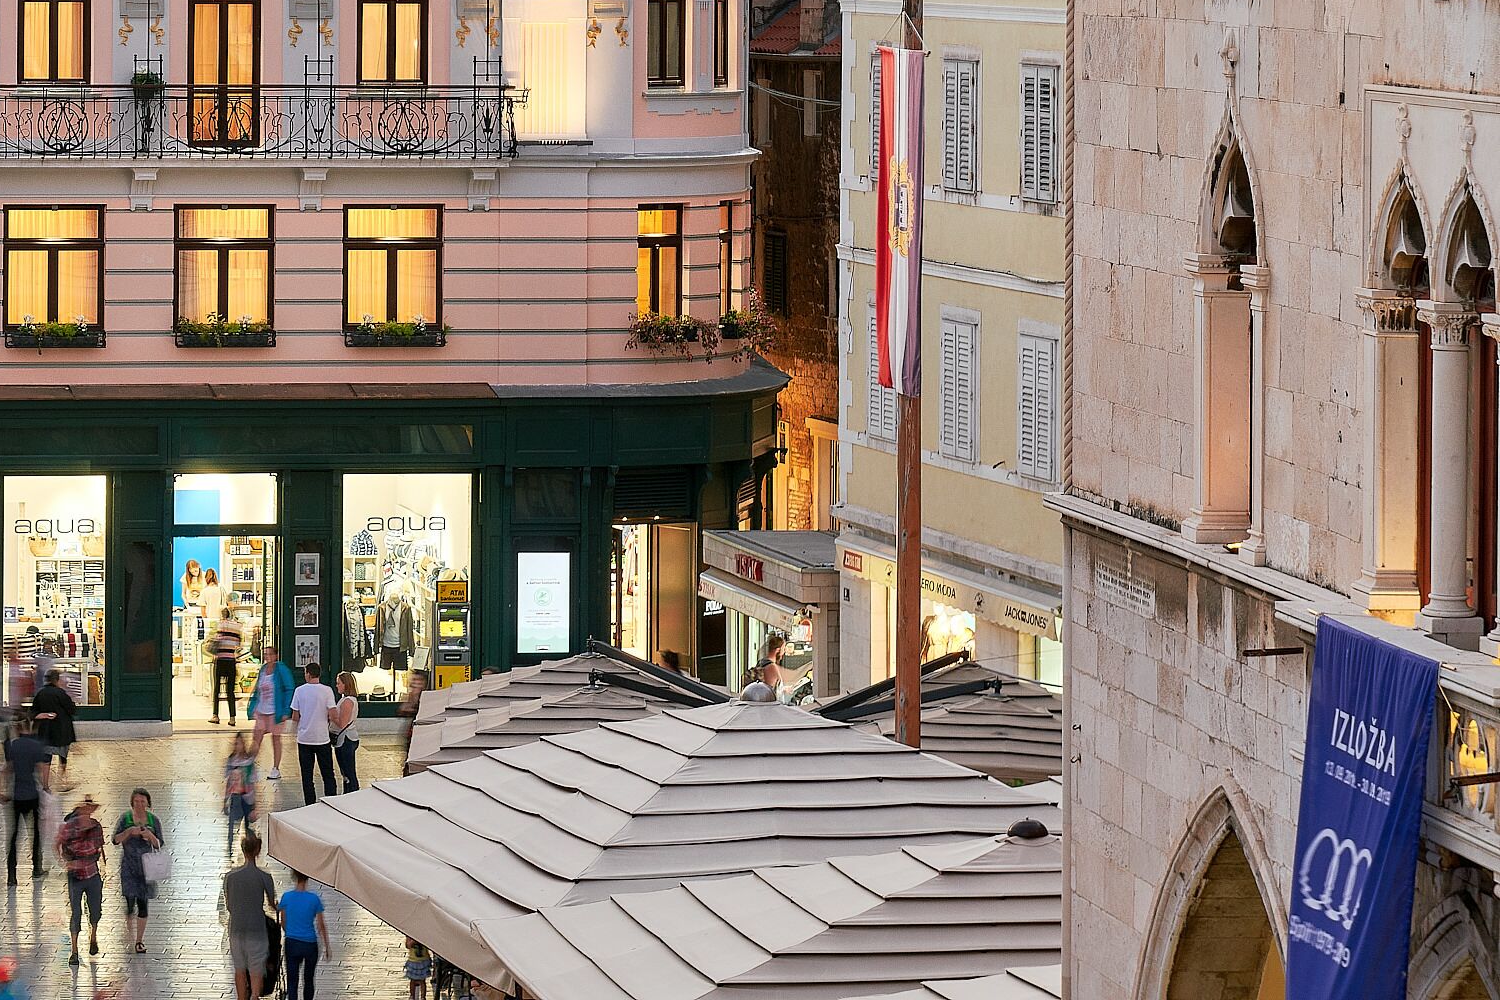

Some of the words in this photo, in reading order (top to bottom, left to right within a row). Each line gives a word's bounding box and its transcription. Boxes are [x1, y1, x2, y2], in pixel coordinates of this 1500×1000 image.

[14, 518, 95, 538] aqua
[367, 516, 446, 536] aqua
[921, 577, 935, 592] ERO
[1330, 707, 1396, 777] IZLOŽBA
